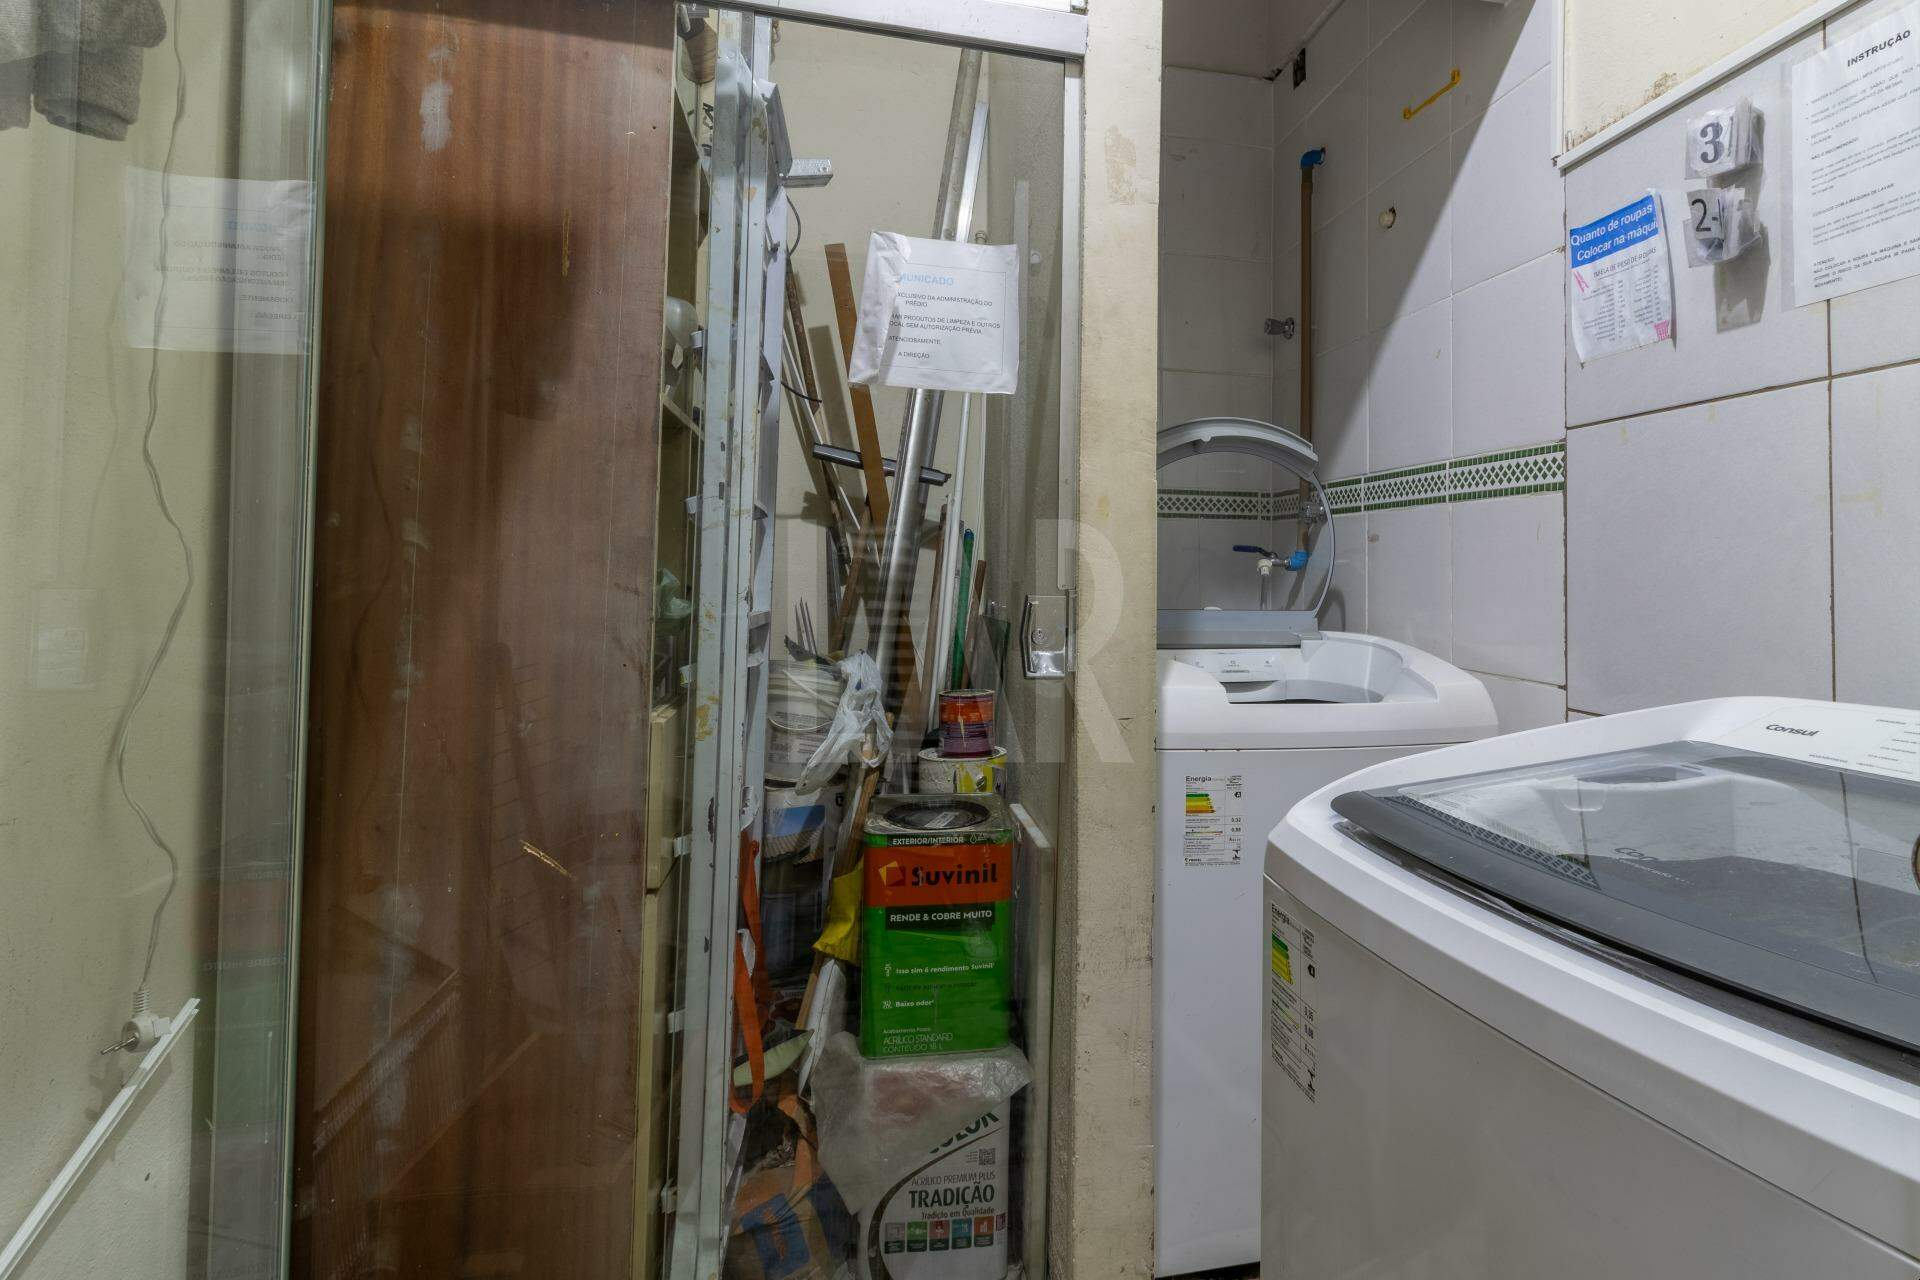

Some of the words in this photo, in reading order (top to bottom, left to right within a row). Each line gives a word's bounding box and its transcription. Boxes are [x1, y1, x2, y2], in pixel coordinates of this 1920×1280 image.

[1847, 30, 1911, 67] INSTRUÇÃO
[1571, 226, 1606, 247] Quanto
[1608, 219, 1619, 233] de
[1620, 204, 1653, 227] roupas
[1577, 241, 1612, 262] Colocar
[1613, 234, 1625, 248] na
[897, 291, 926, 300] XCLUSIVO
[904, 315, 936, 323] PRODUTOS
[1765, 724, 1820, 737] Consul
[1185, 775, 1212, 783] Energia
[892, 836, 964, 846] EXTERIOR/INTERIOR
[911, 863, 998, 887] Suvinil
[890, 912, 920, 922] RENDE
[922, 912, 930, 921] &
[931, 911, 961, 921] COBRE
[963, 909, 993, 919] MUITO
[930, 964, 969, 973] rendimento
[895, 1000, 915, 1008] Baixo
[943, 1172, 977, 1185] PREMIUM
[978, 1171, 996, 1181] PLUS
[908, 1182, 995, 1208] TRADIÇÃO
[921, 1210, 949, 1220] Tradição
[949, 1210, 961, 1218] em
[962, 1207, 995, 1217] Qualidade
